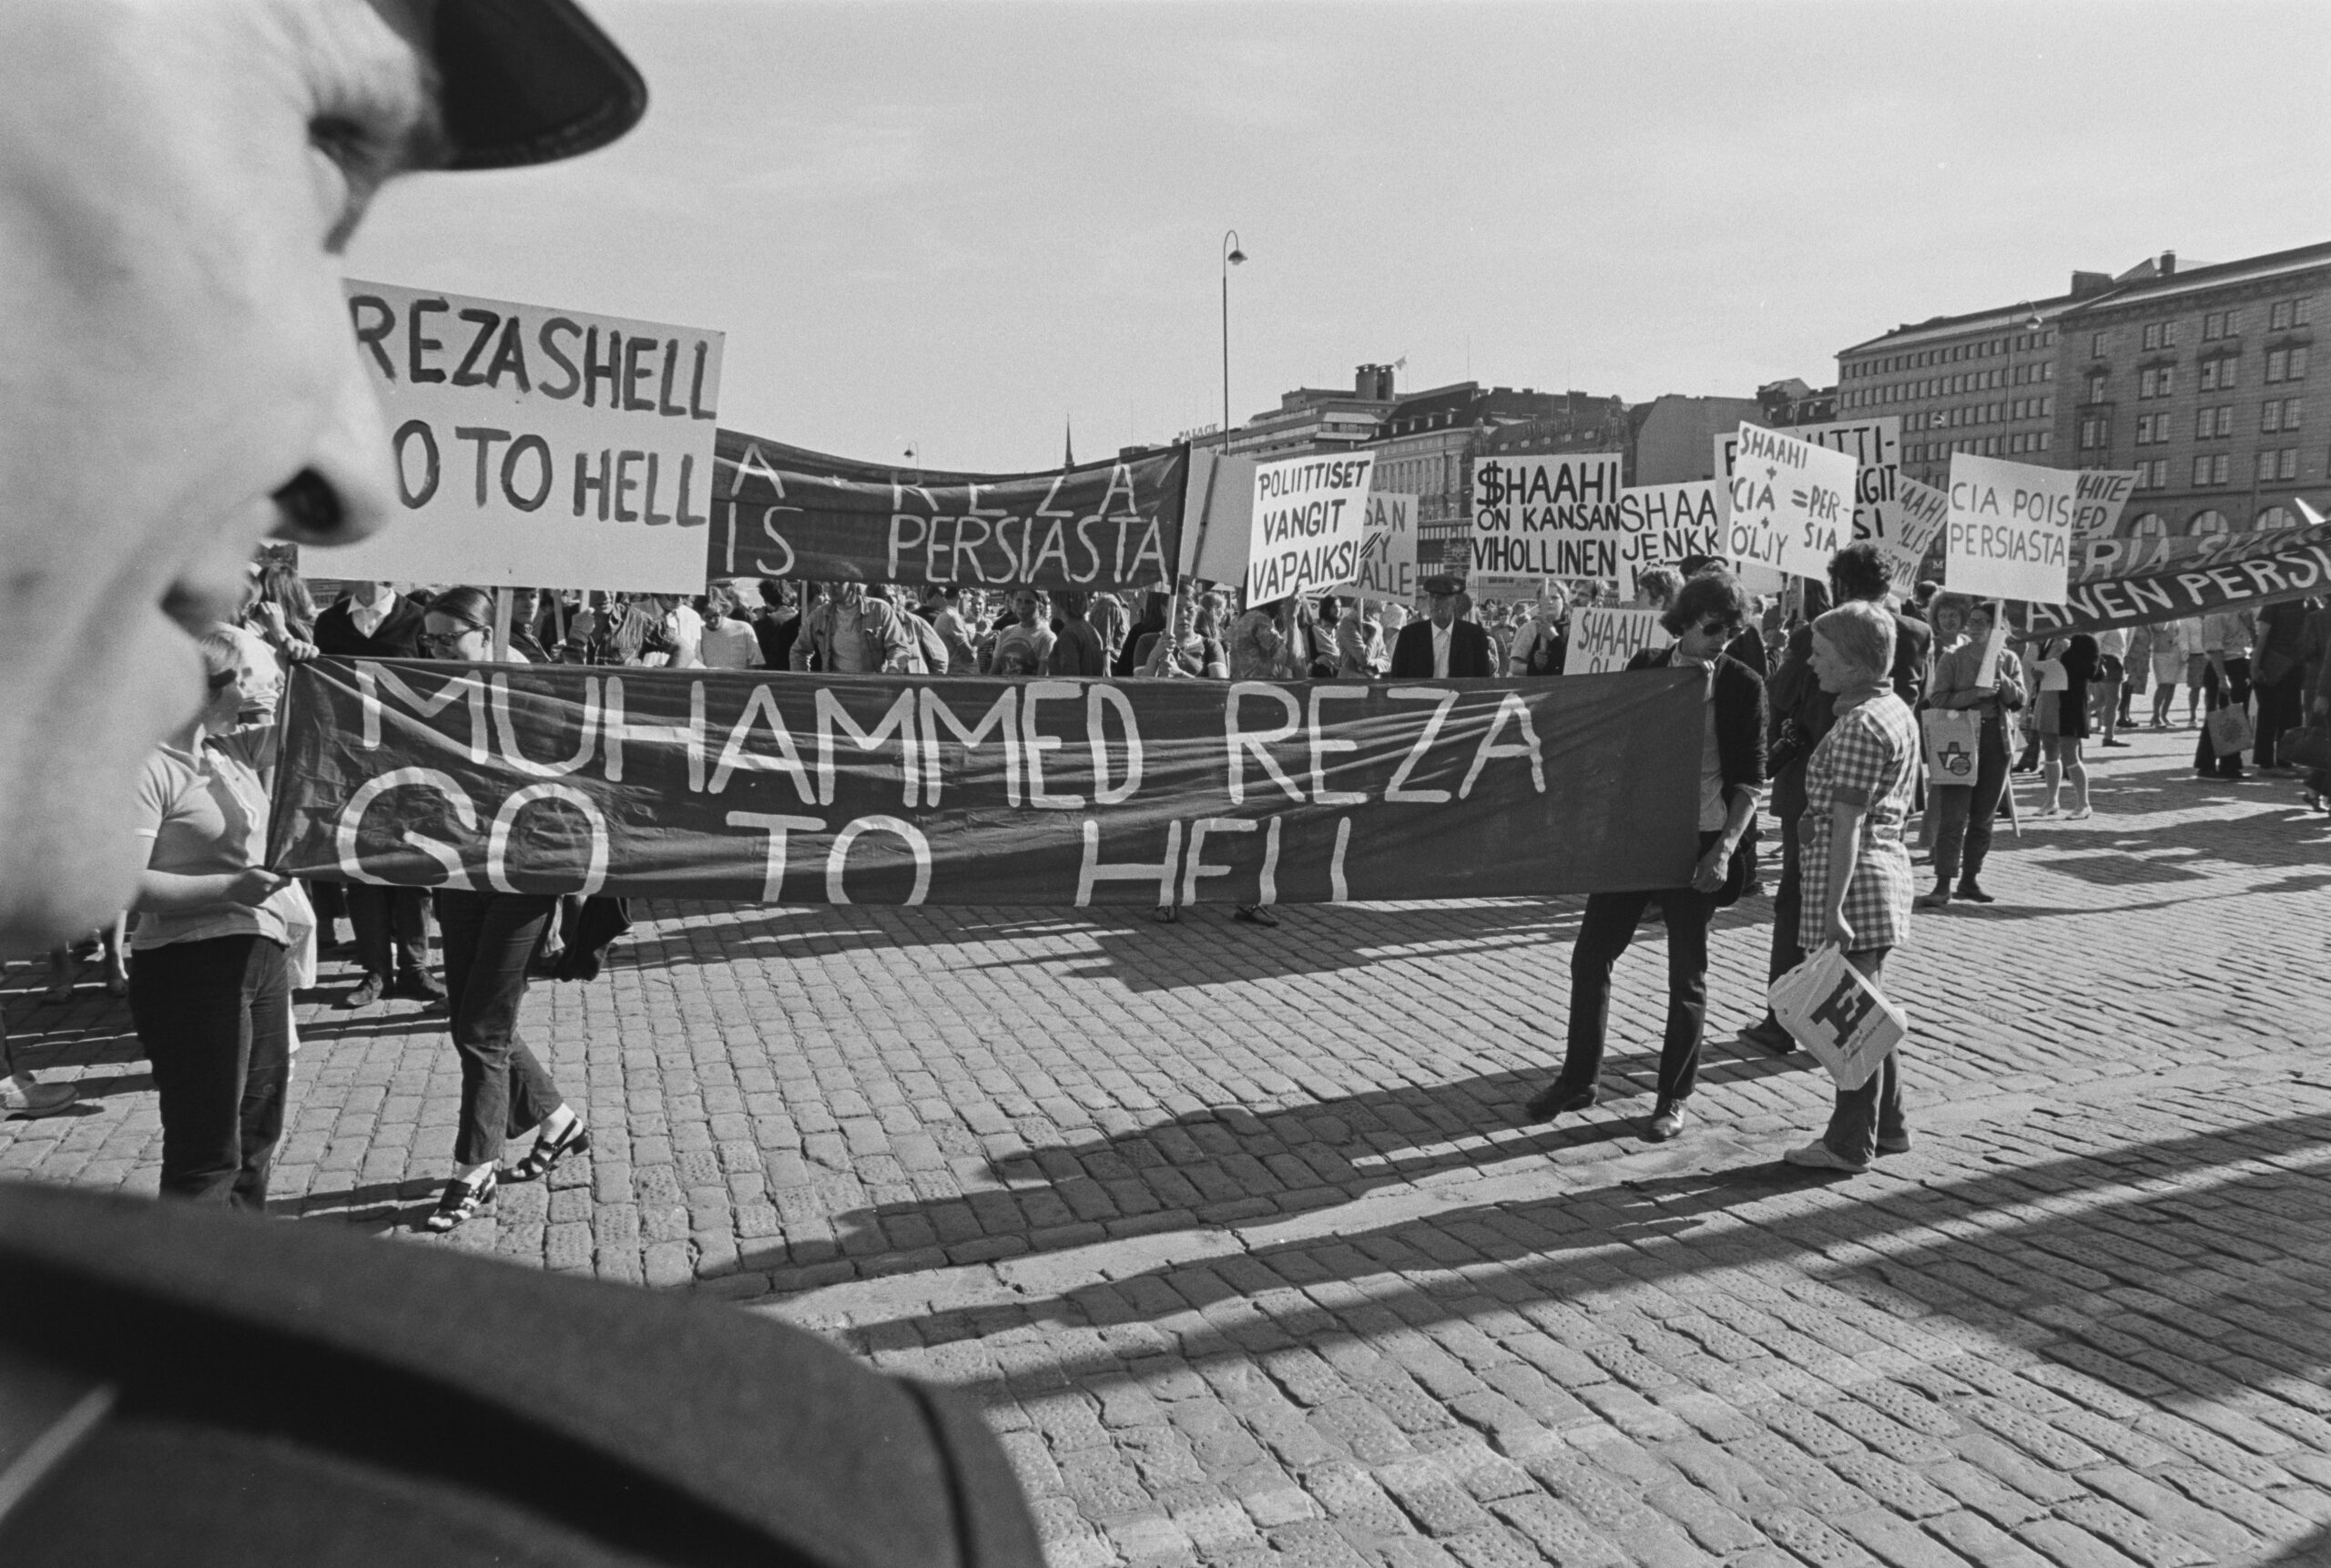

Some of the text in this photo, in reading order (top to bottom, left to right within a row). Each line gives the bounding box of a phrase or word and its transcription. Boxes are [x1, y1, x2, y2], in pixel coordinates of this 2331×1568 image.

[1740, 427, 1807, 469] SHAAHI
[455, 426, 553, 512] TO
[573, 449, 707, 527] HELL
[1258, 460, 1370, 501] POLIITTISET
[1476, 461, 1617, 508] $HAAHI
[1733, 476, 1776, 513] CIA
[1264, 499, 1347, 545] VANGIT
[1477, 503, 1620, 532] ON KANSAN
[1621, 489, 1718, 533] SHAA
[1951, 483, 2070, 527] CIA POIS
[887, 514, 1170, 585] PERSIASTA
[1471, 535, 1616, 576] VIHOLLINEN
[1731, 520, 1788, 565] ÖLJY
[1804, 522, 1837, 554] SIA
[1950, 523, 2065, 567] PERSIASTA
[1253, 540, 1359, 601] VAPAIKSI
[1577, 611, 1654, 659] SHAAHI
[356, 660, 1545, 809] MUHAMMED REZA
[336, 766, 609, 896] GO
[726, 809, 932, 905] TO
